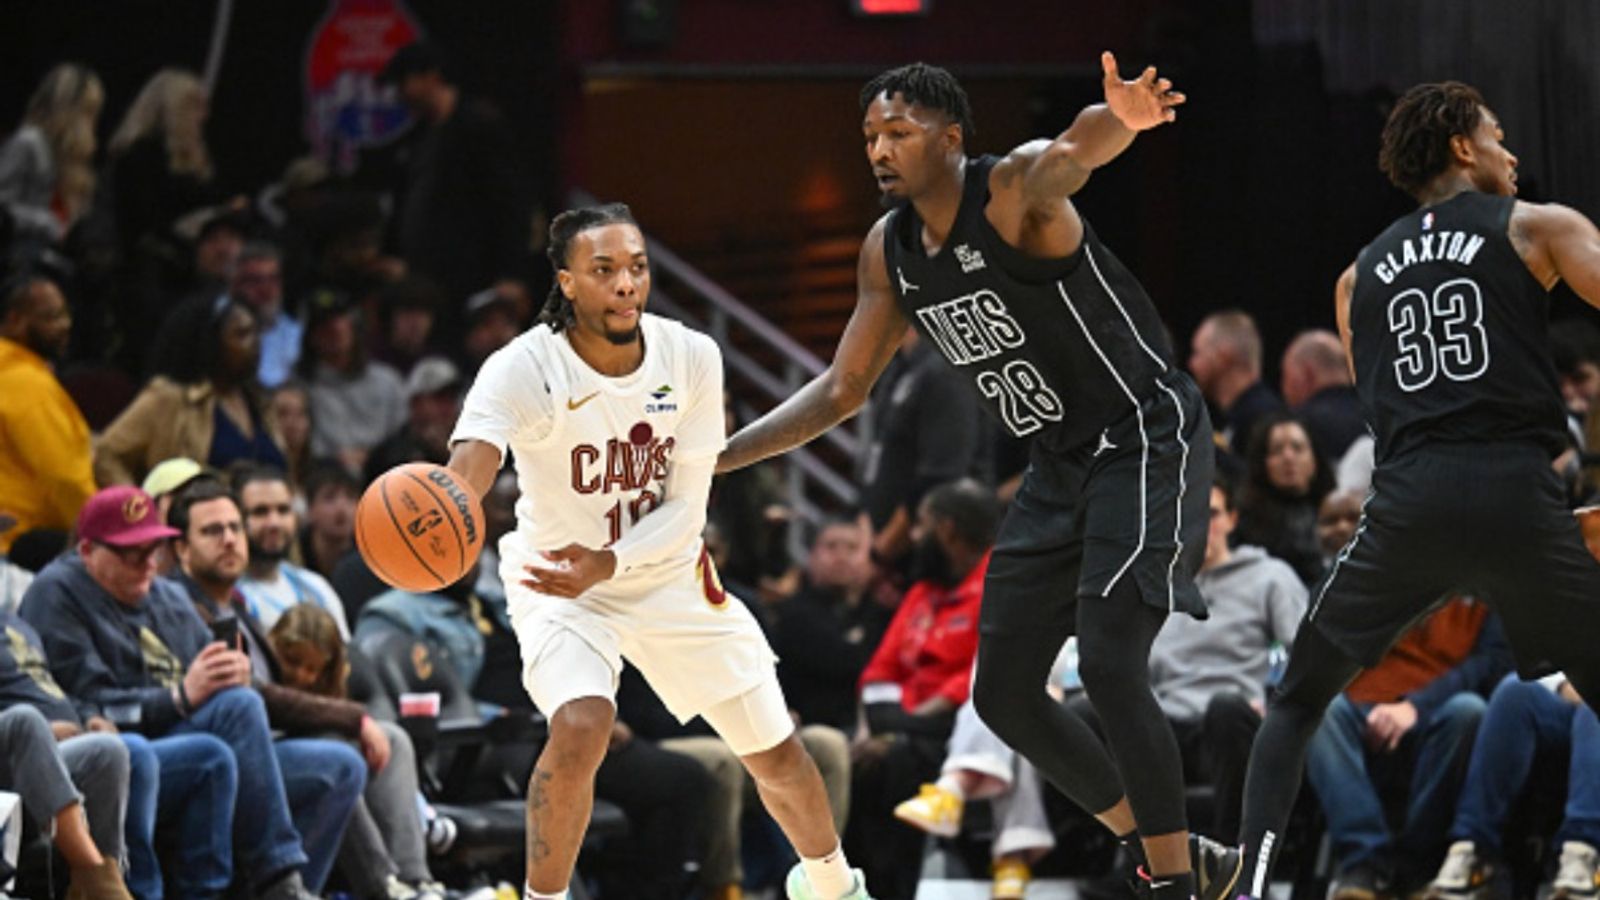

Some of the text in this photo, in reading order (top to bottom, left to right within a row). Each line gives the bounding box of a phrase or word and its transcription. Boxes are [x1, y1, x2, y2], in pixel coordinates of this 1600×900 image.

[1374, 231, 1485, 285] CLAXTON
[916, 289, 1026, 365] NETS
[1387, 277, 1490, 392] 33
[977, 360, 1065, 437] 28
[570, 436, 675, 495] CAVS
